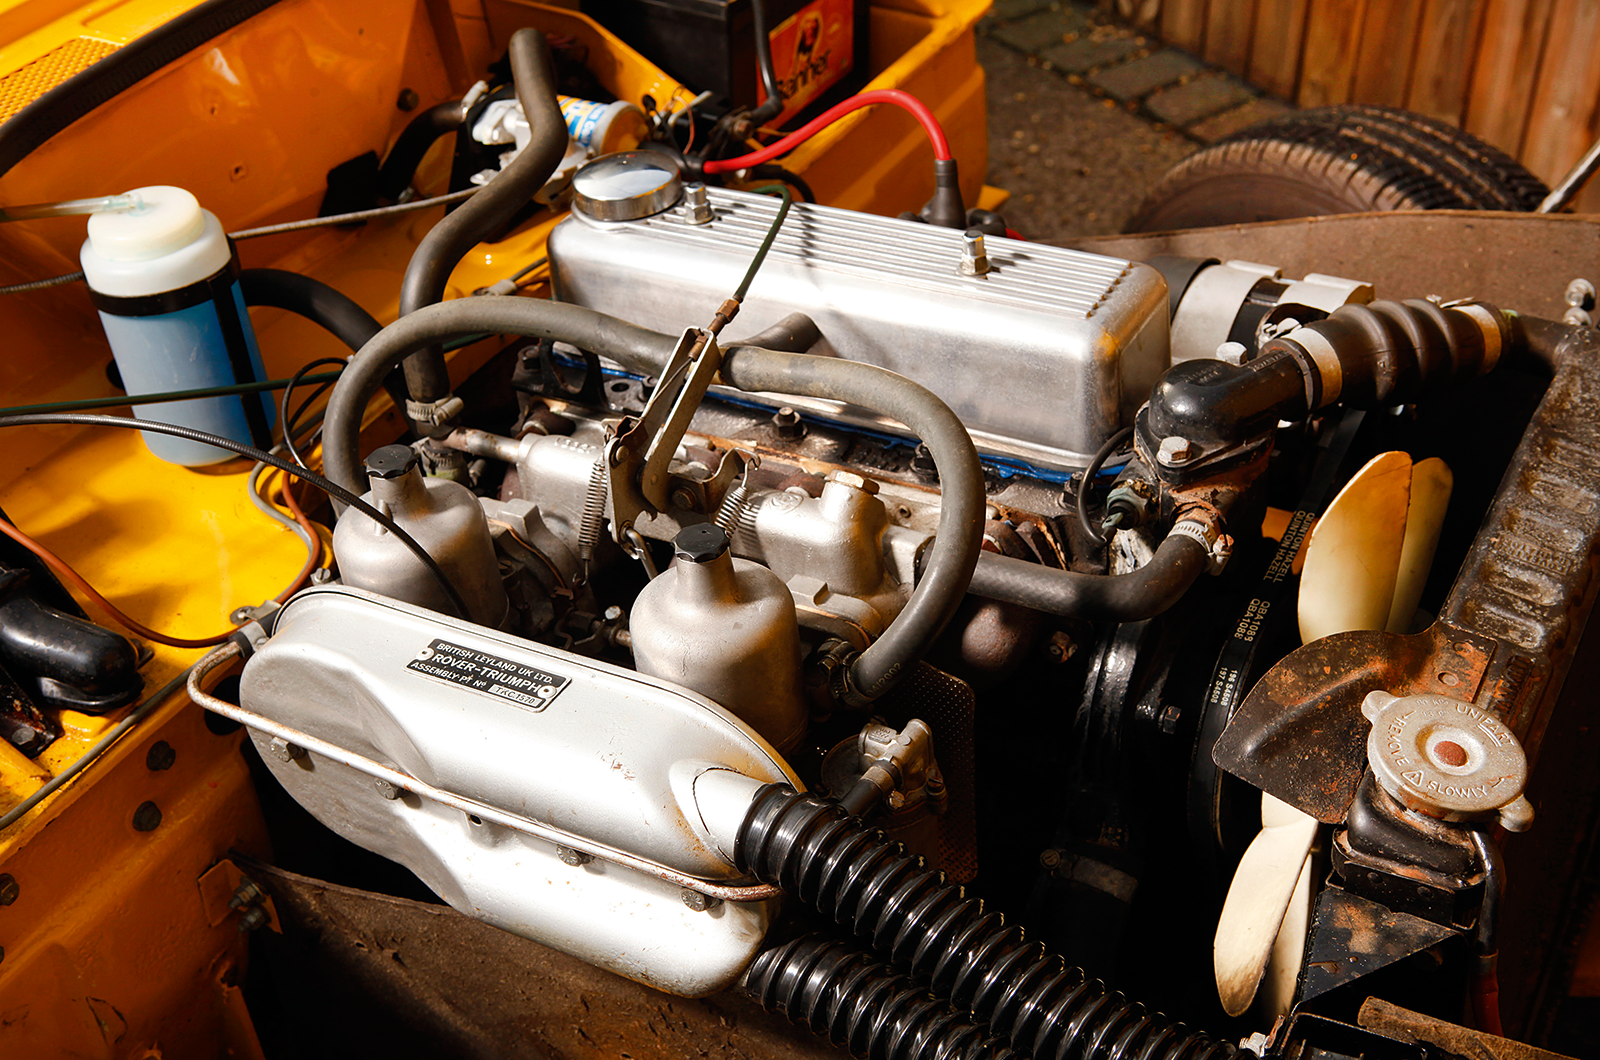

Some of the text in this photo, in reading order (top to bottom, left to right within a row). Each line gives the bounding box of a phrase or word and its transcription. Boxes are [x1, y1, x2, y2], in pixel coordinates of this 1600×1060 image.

[1263, 510, 1306, 580] QUINTON HAZELL
[1273, 512, 1315, 583] QUINTON HAZELL
[411, 662, 458, 679] ASSEMBLY
[431, 653, 542, 693] ROVER-TRIUMPH
[436, 643, 552, 684] BRITISH LEYLAND UK LTD.
[1388, 717, 1410, 766] REMOVE
[1456, 703, 1515, 747] UNIPART
[1426, 780, 1488, 799] SLOWLY
